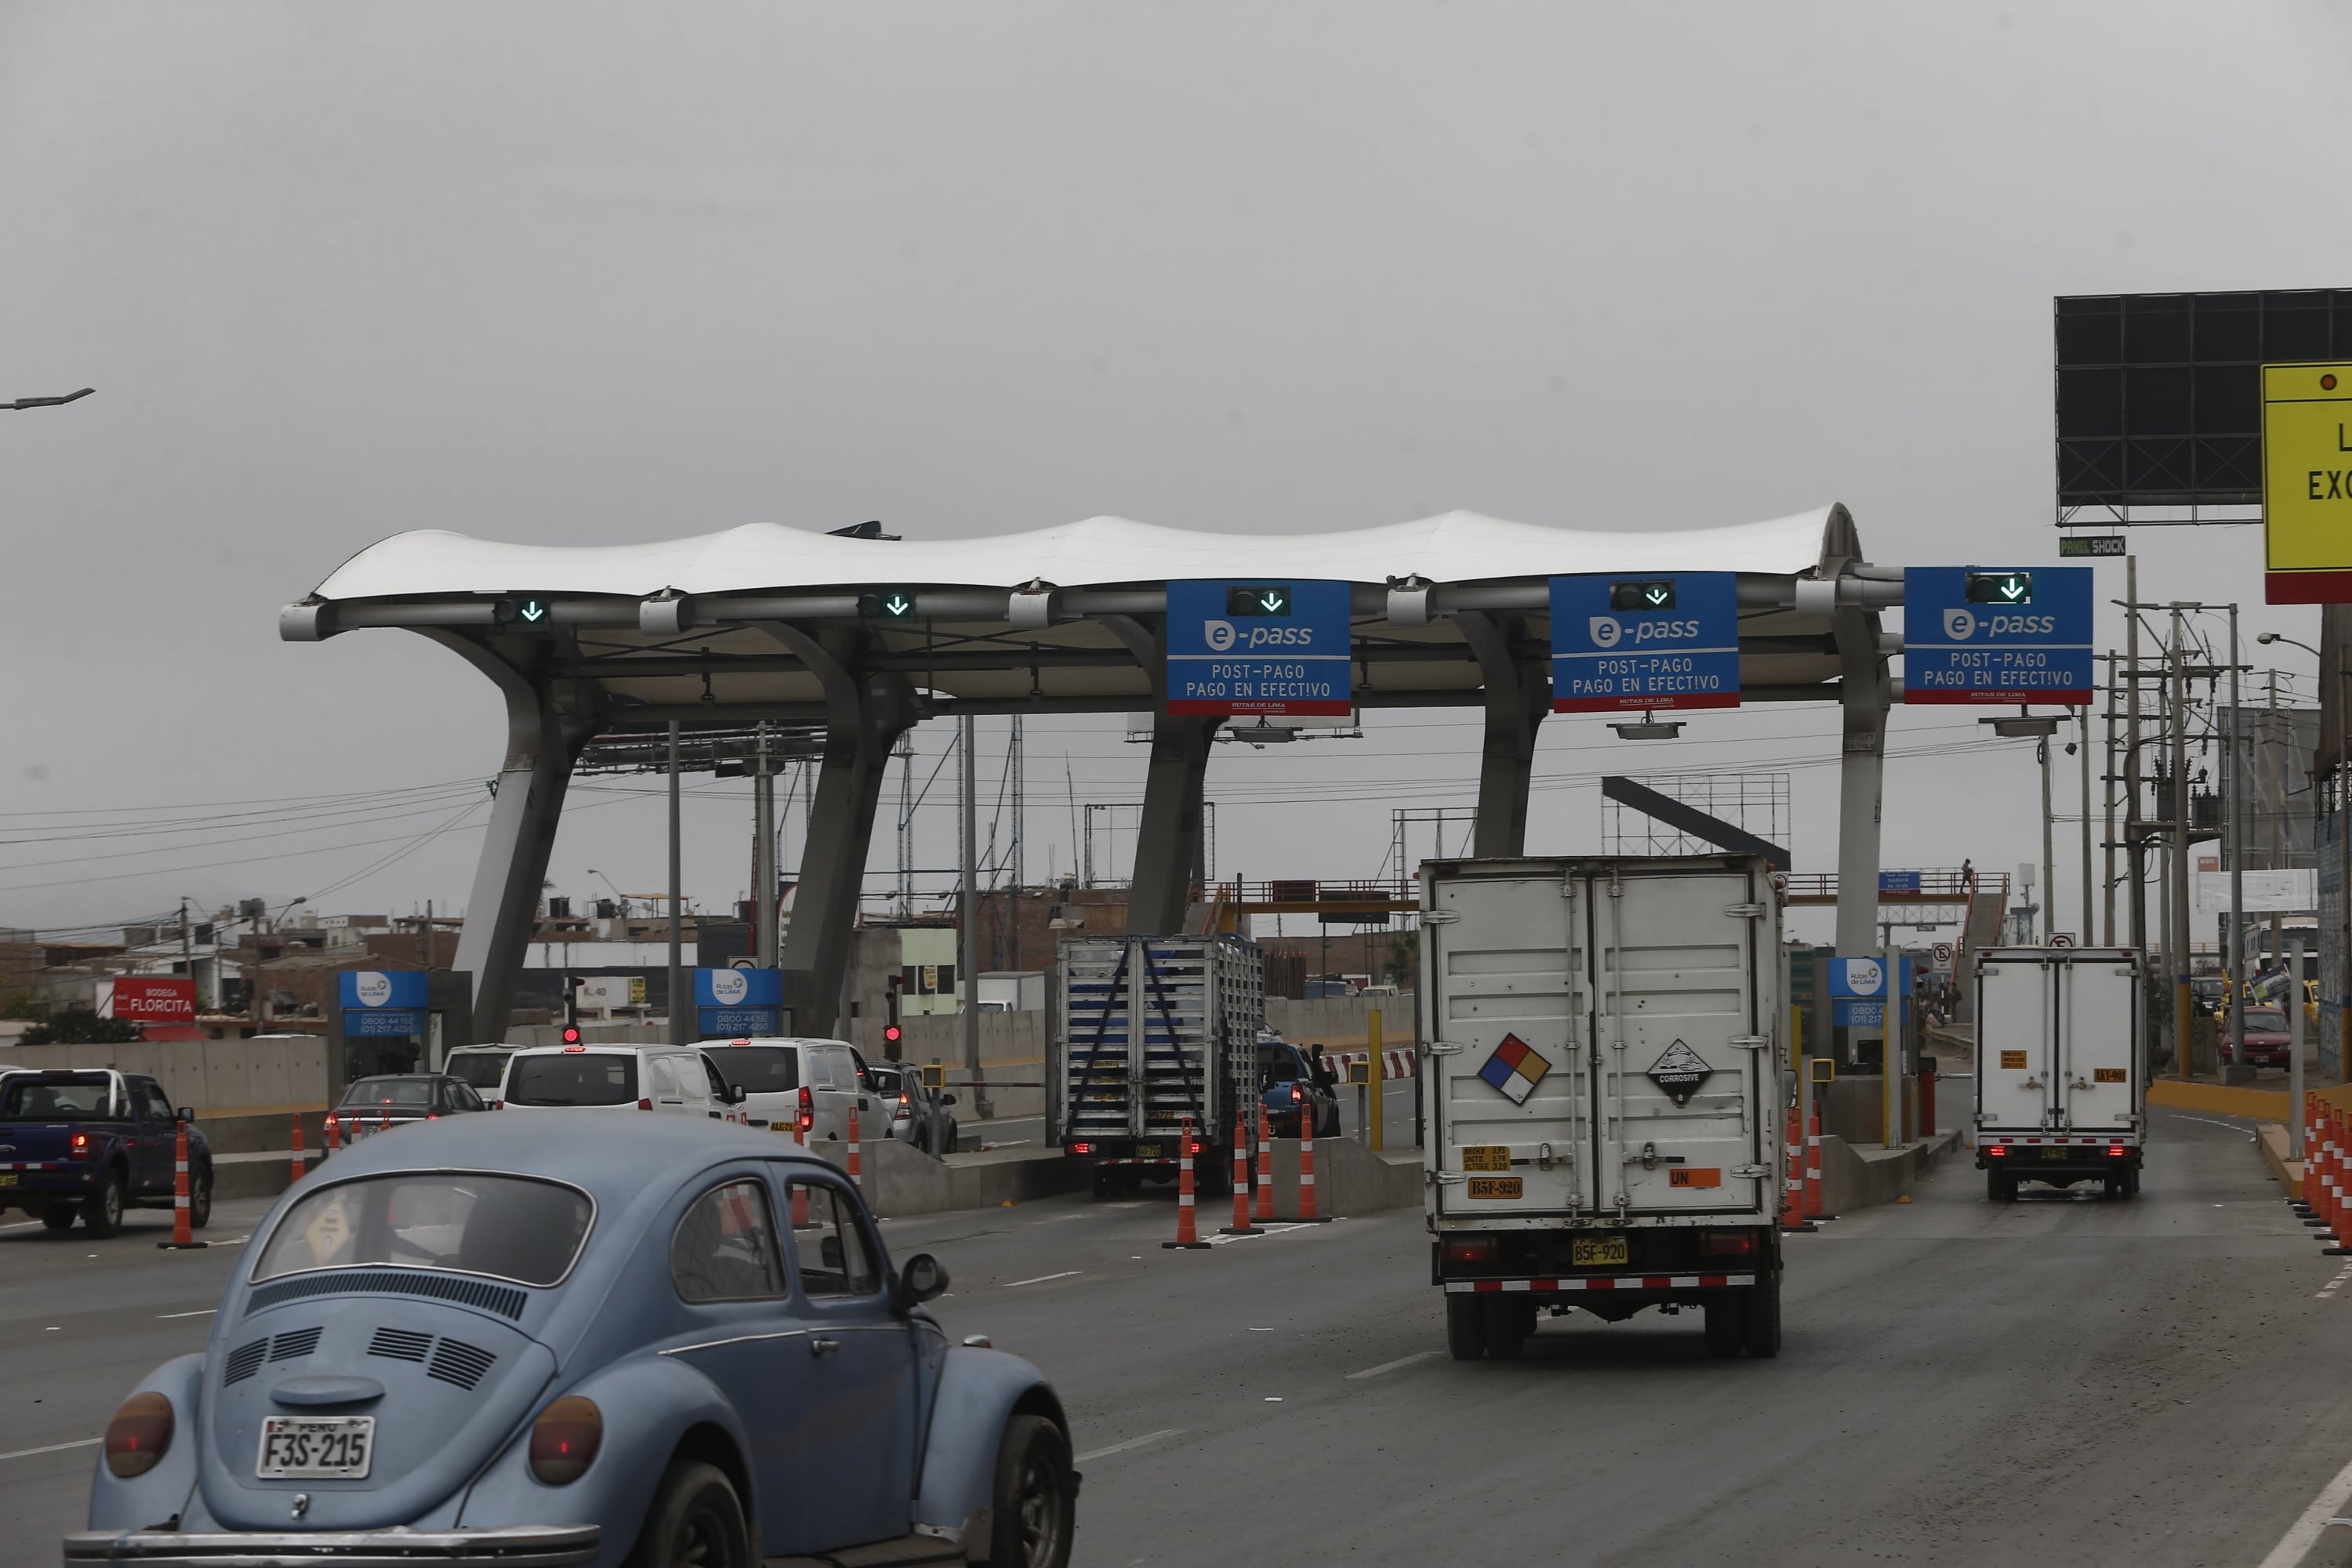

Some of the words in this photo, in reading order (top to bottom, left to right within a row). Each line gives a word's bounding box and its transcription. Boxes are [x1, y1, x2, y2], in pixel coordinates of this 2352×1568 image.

[2061, 539, 2090, 554] PANEL
[2092, 536, 2125, 554] SHOCK
[1944, 609, 2055, 640] e-pass
[1204, 620, 1313, 651] e-pass
[1589, 617, 1700, 648] e-pass
[1599, 658, 1693, 675] POST-PAGO
[1951, 653, 2046, 667] POST-PAGO
[1212, 664, 1305, 679] POST-PAGO
[1924, 671, 1965, 685] PAGO
[1974, 671, 1992, 685] EN
[1186, 682, 1225, 697] PAGO
[1235, 682, 1253, 697] EN
[1573, 678, 1613, 694] PAGO
[1622, 677, 1640, 691] EN
[130, 998, 192, 1012] FLORCITA
[1851, 1015, 1866, 1024] (01)
[361, 1025, 375, 1034] (01)
[717, 1023, 731, 1032] (01)
[1659, 1074, 1700, 1083] CORROSIVE
[1671, 1171, 1688, 1185] UN
[1472, 1181, 1520, 1195] B5F-920
[1575, 1243, 1625, 1261] B5F-920
[264, 1433, 366, 1467] F3S-215
